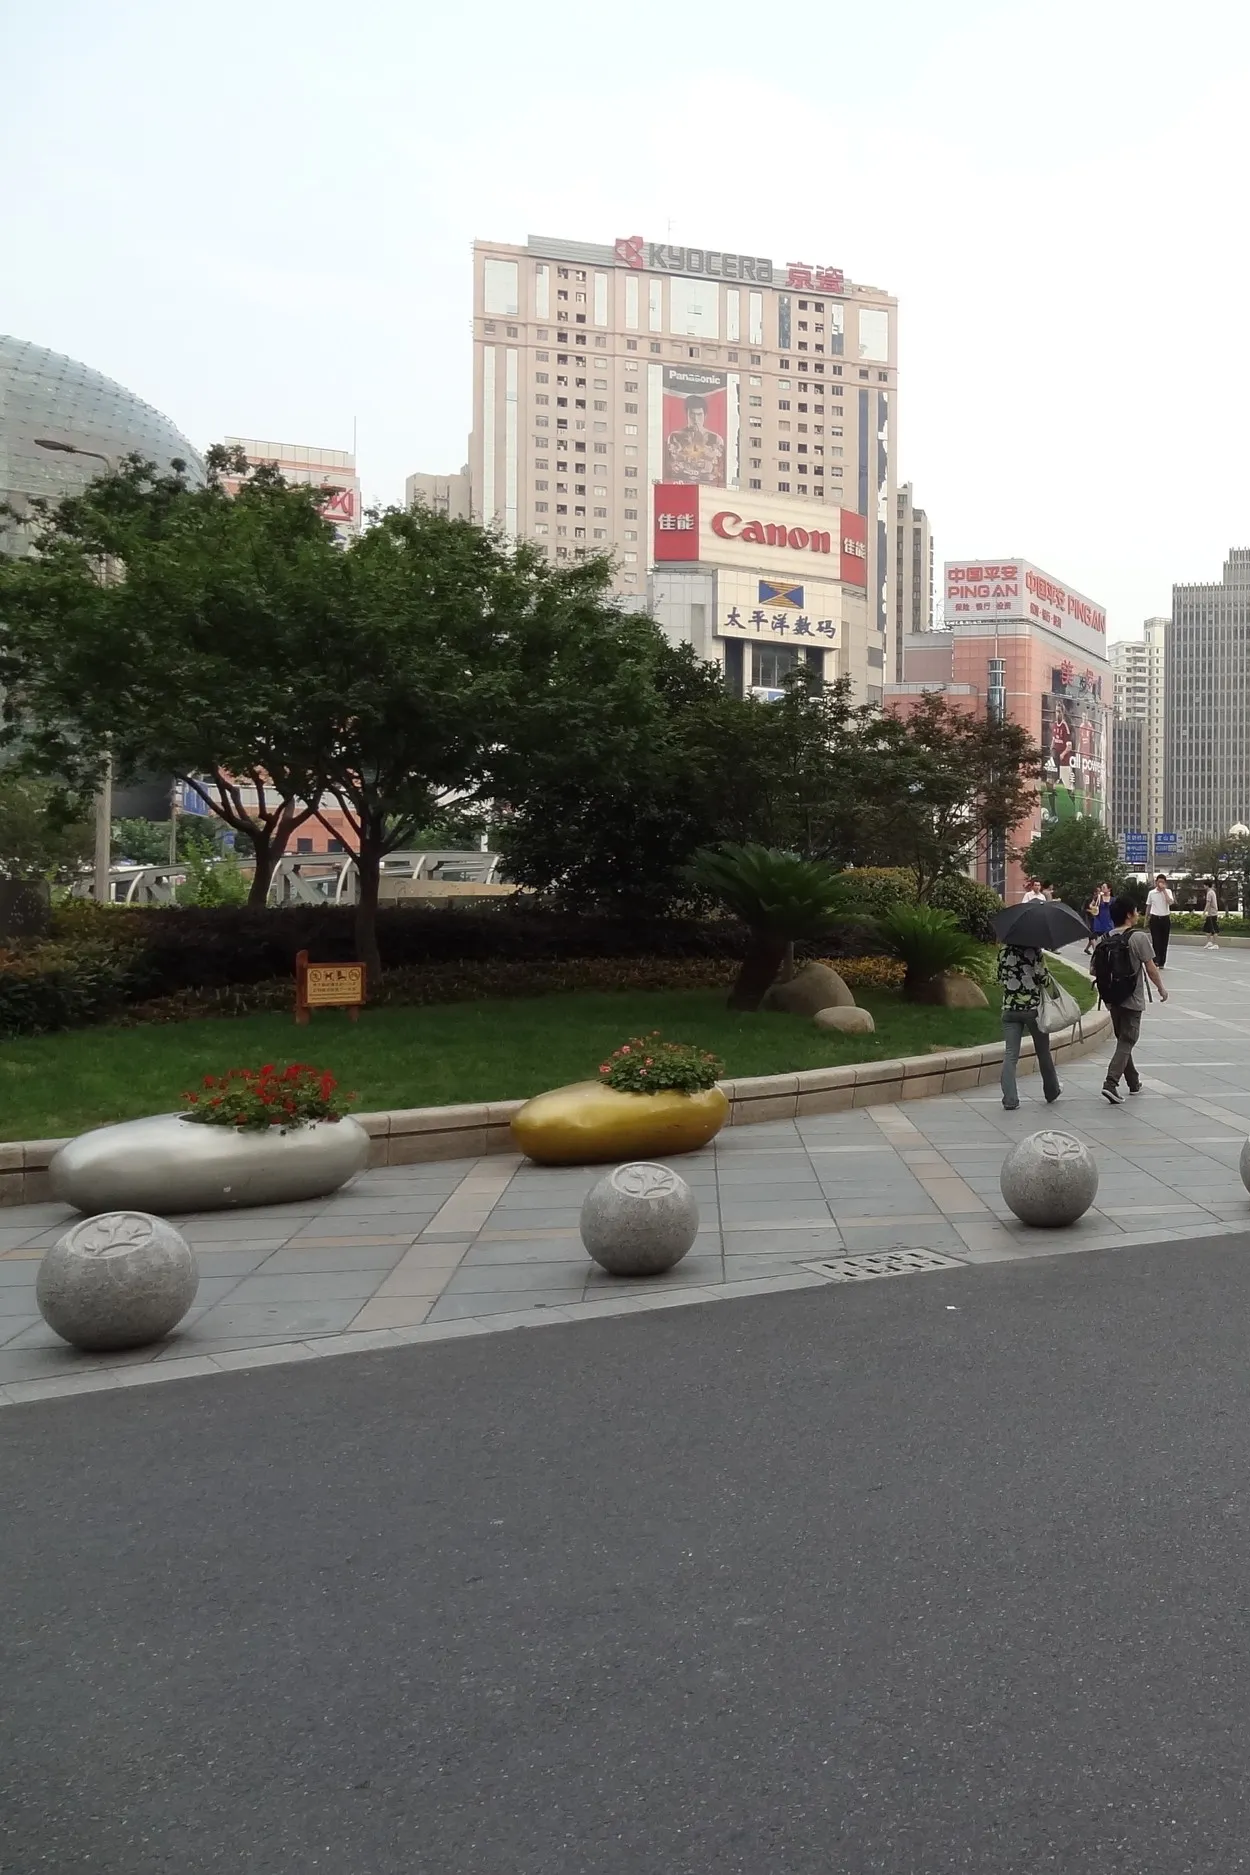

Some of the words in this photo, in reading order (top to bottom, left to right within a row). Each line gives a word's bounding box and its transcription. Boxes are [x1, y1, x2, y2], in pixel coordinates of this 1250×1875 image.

[649, 243, 773, 283] KYOCERA
[785, 262, 845, 294] 京瓷
[669, 370, 721, 385] Panasonic
[658, 513, 694, 531] 佳能
[711, 511, 831, 553] Canon
[843, 537, 866, 559] 佳能
[948, 566, 1018, 583] 中国平安
[1025, 570, 1065, 612] 中国平安
[724, 607, 836, 639] 太平洋数码
